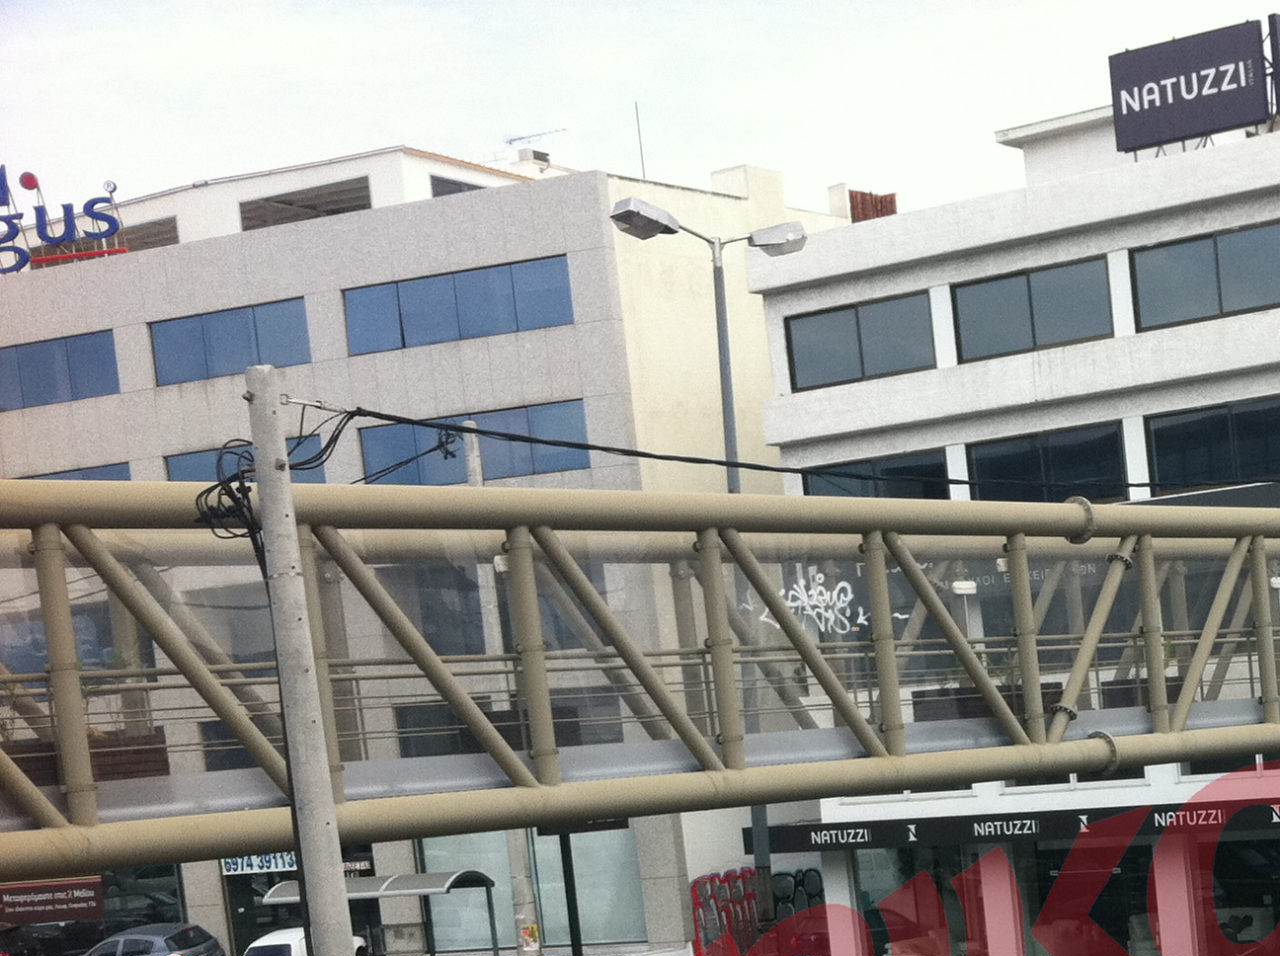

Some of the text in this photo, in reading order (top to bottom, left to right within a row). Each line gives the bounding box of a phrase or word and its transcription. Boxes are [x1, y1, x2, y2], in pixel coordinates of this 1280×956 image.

[1120, 61, 1246, 115] NATUZZI
[1154, 809, 1222, 827] NATUZZI
[811, 829, 868, 845] NATUZZI
[973, 820, 1036, 837] NATUZZI
